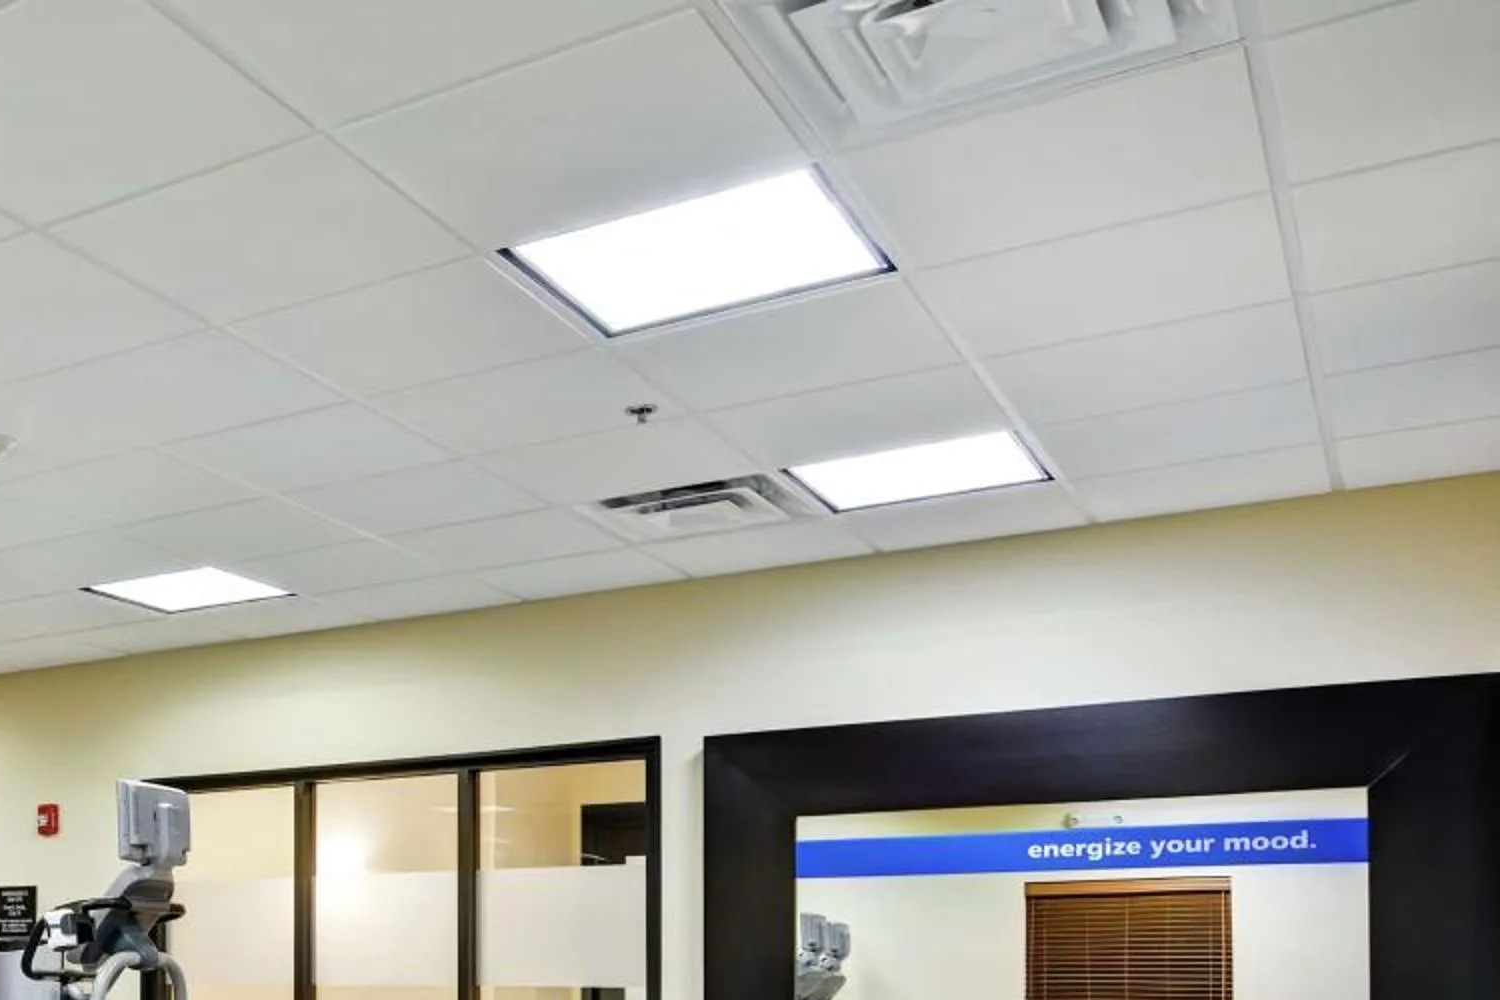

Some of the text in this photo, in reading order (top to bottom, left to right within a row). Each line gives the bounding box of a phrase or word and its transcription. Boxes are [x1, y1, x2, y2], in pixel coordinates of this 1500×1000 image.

[1027, 829, 1318, 862] energize your mood.
